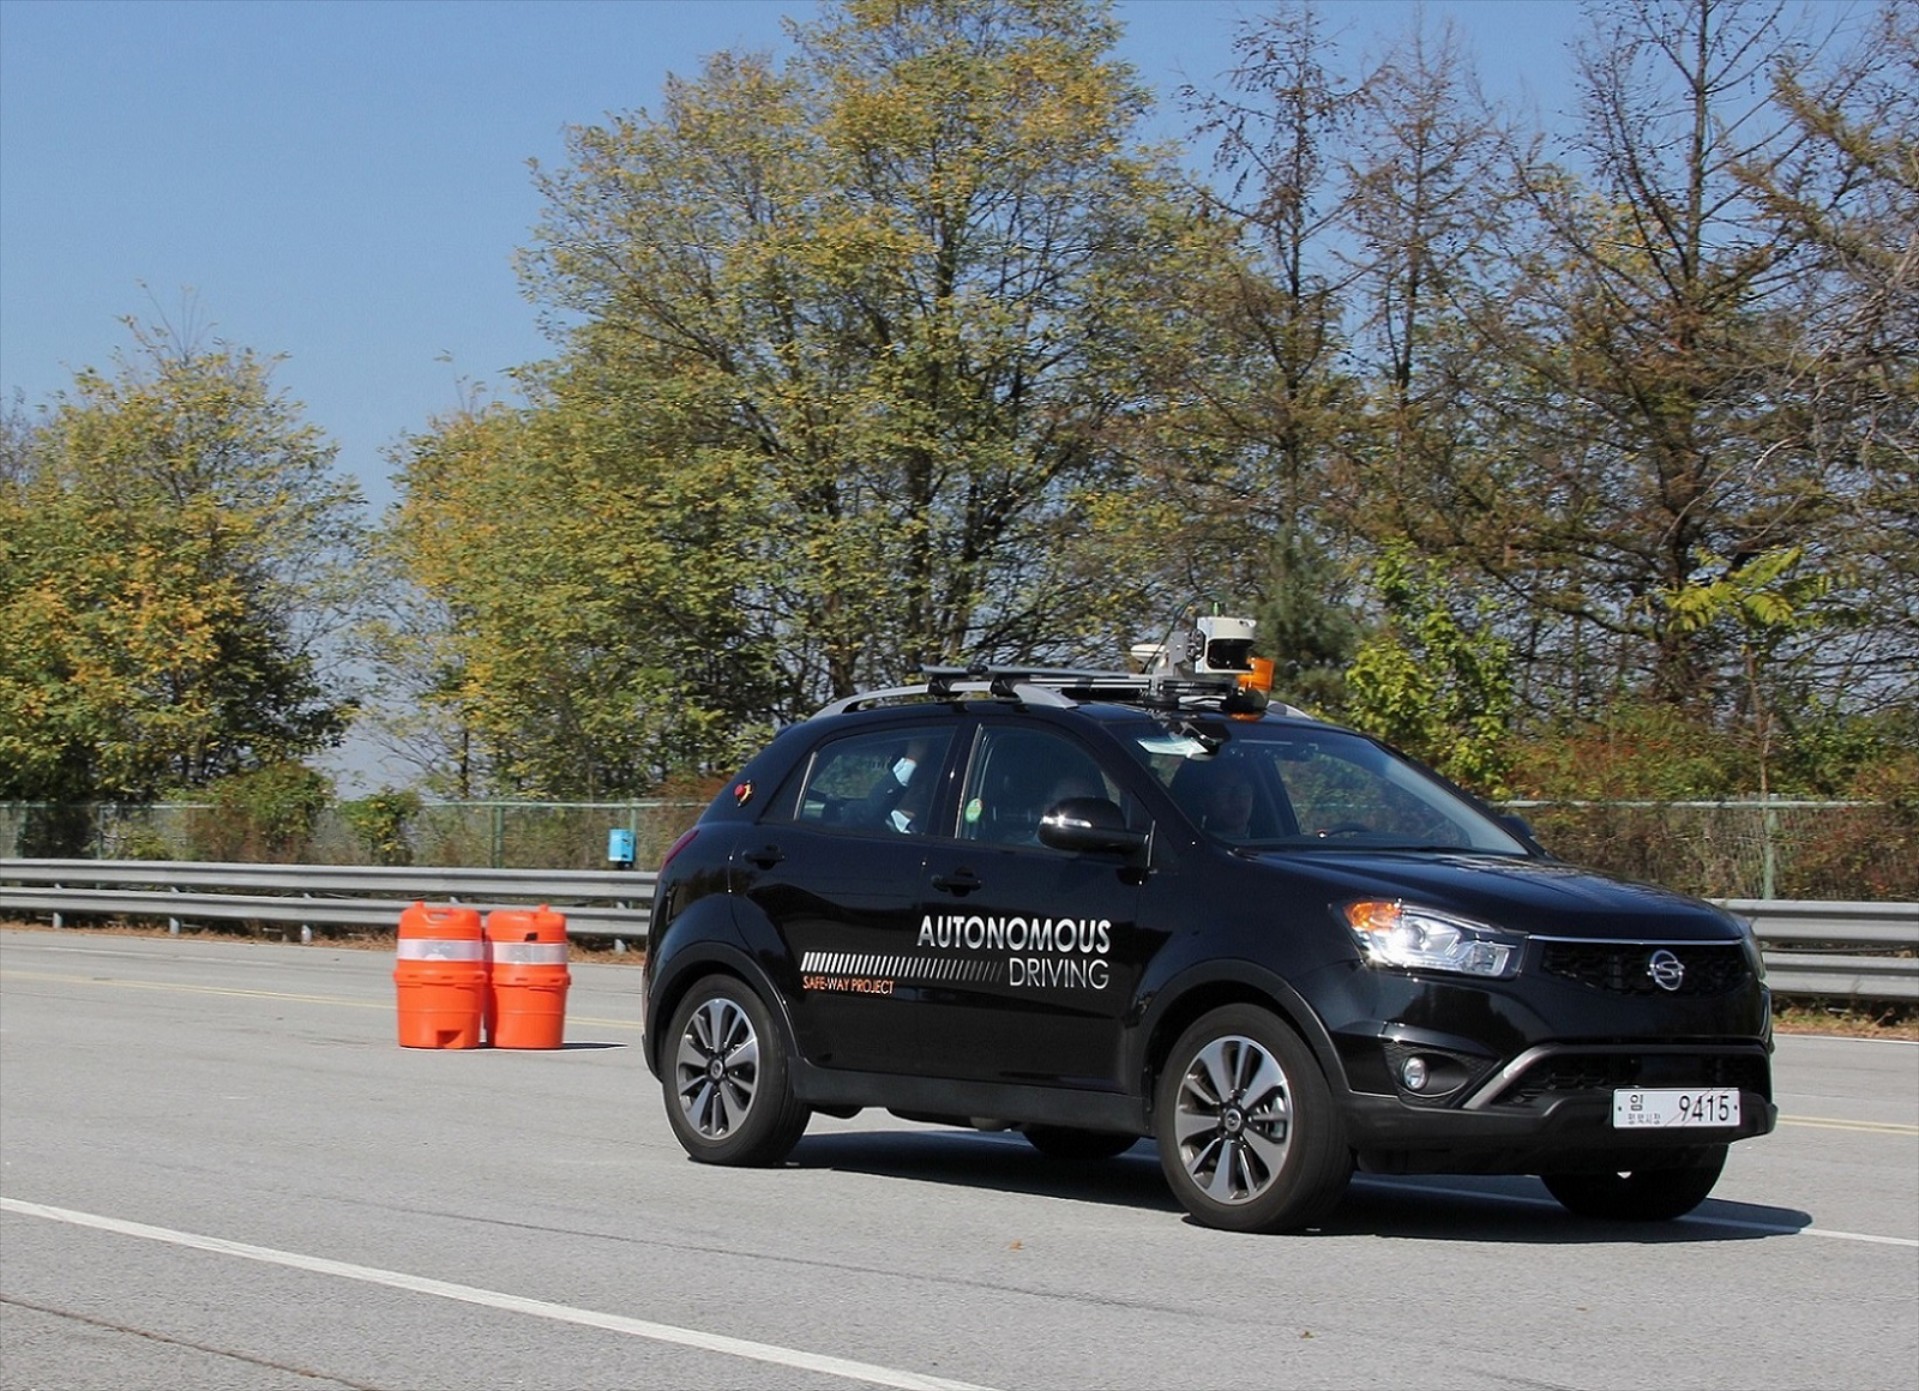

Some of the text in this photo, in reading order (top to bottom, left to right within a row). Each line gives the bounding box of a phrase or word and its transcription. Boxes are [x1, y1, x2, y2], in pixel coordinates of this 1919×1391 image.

[916, 915, 1112, 953] AUTONOMOUS
[802, 975, 895, 995] SAFE-WAY PROJECT
[1009, 957, 1109, 989] DRIVING
[1630, 1094, 1730, 1122] 임 9415
